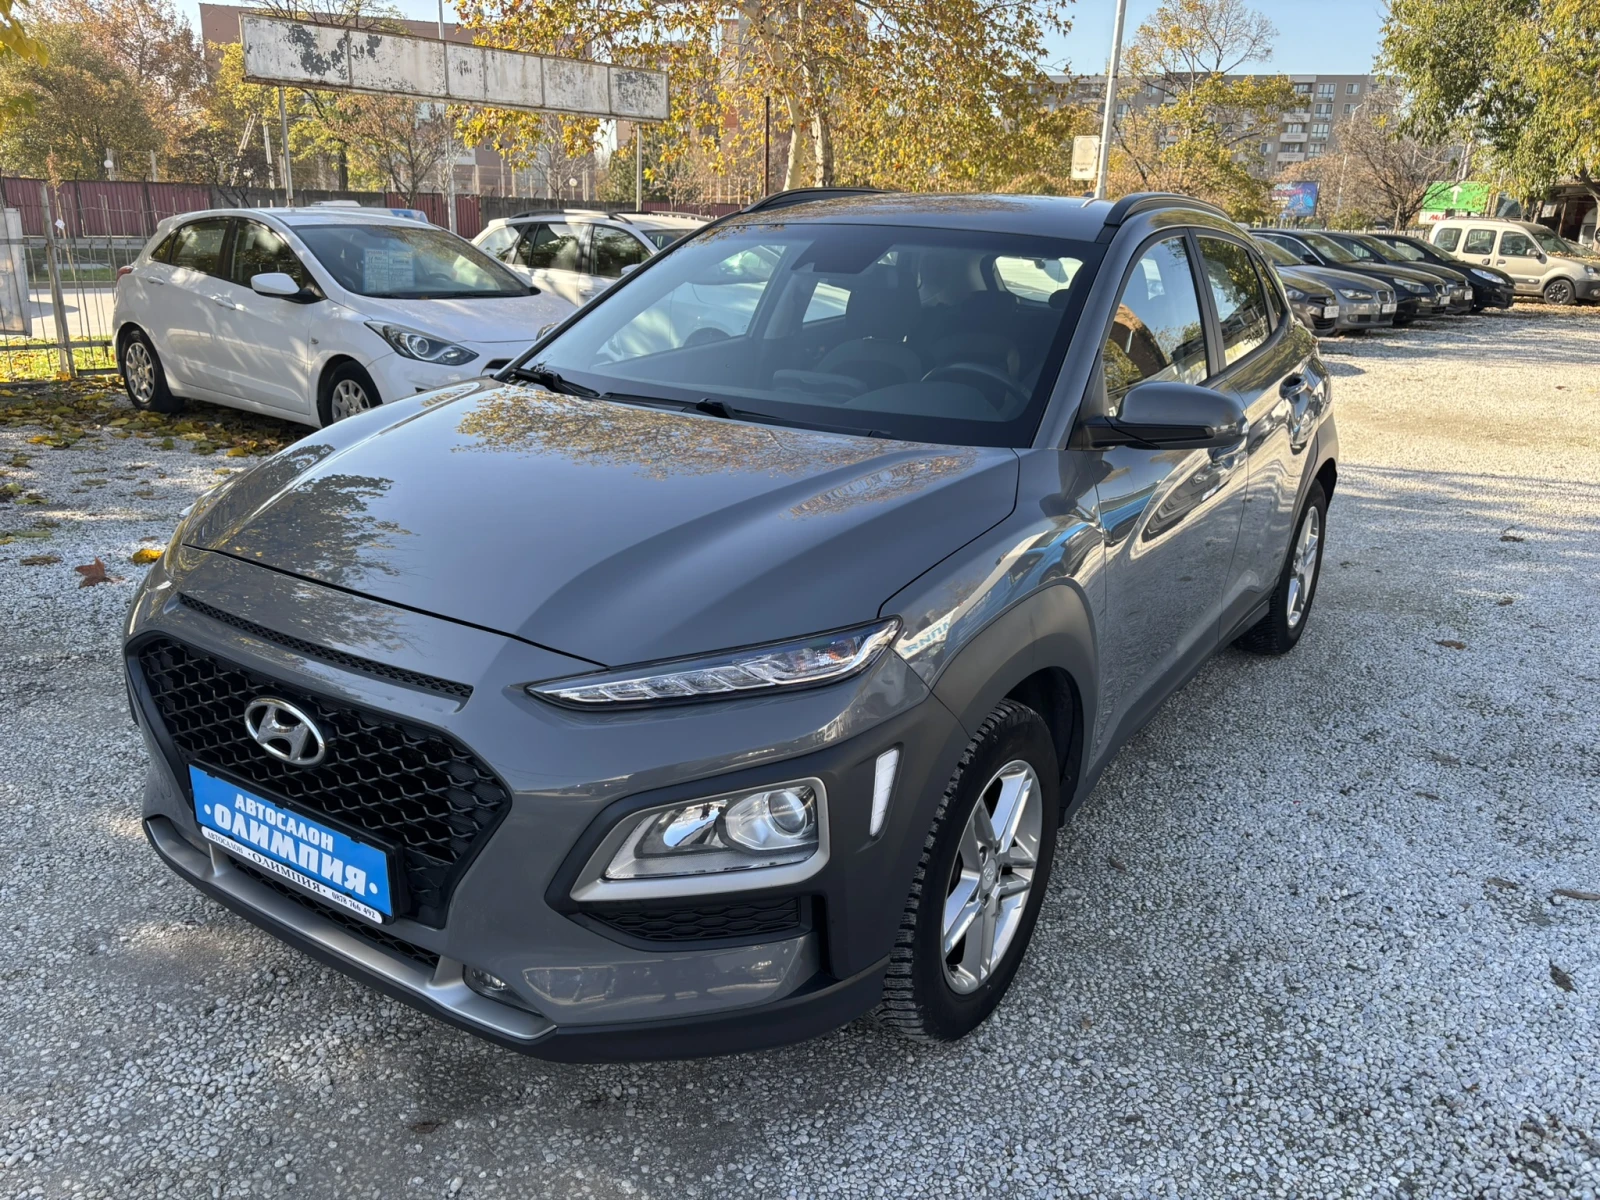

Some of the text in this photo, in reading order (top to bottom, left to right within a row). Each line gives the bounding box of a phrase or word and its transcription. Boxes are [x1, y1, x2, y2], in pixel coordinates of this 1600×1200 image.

[214, 803, 367, 896] ОЛИМПИЯ
[234, 793, 333, 853] АВТОСАЛОН
[207, 831, 243, 854] АВТОСАЛОН
[252, 852, 321, 893] ОЛИМПИЯ
[363, 907, 376, 918] 492
